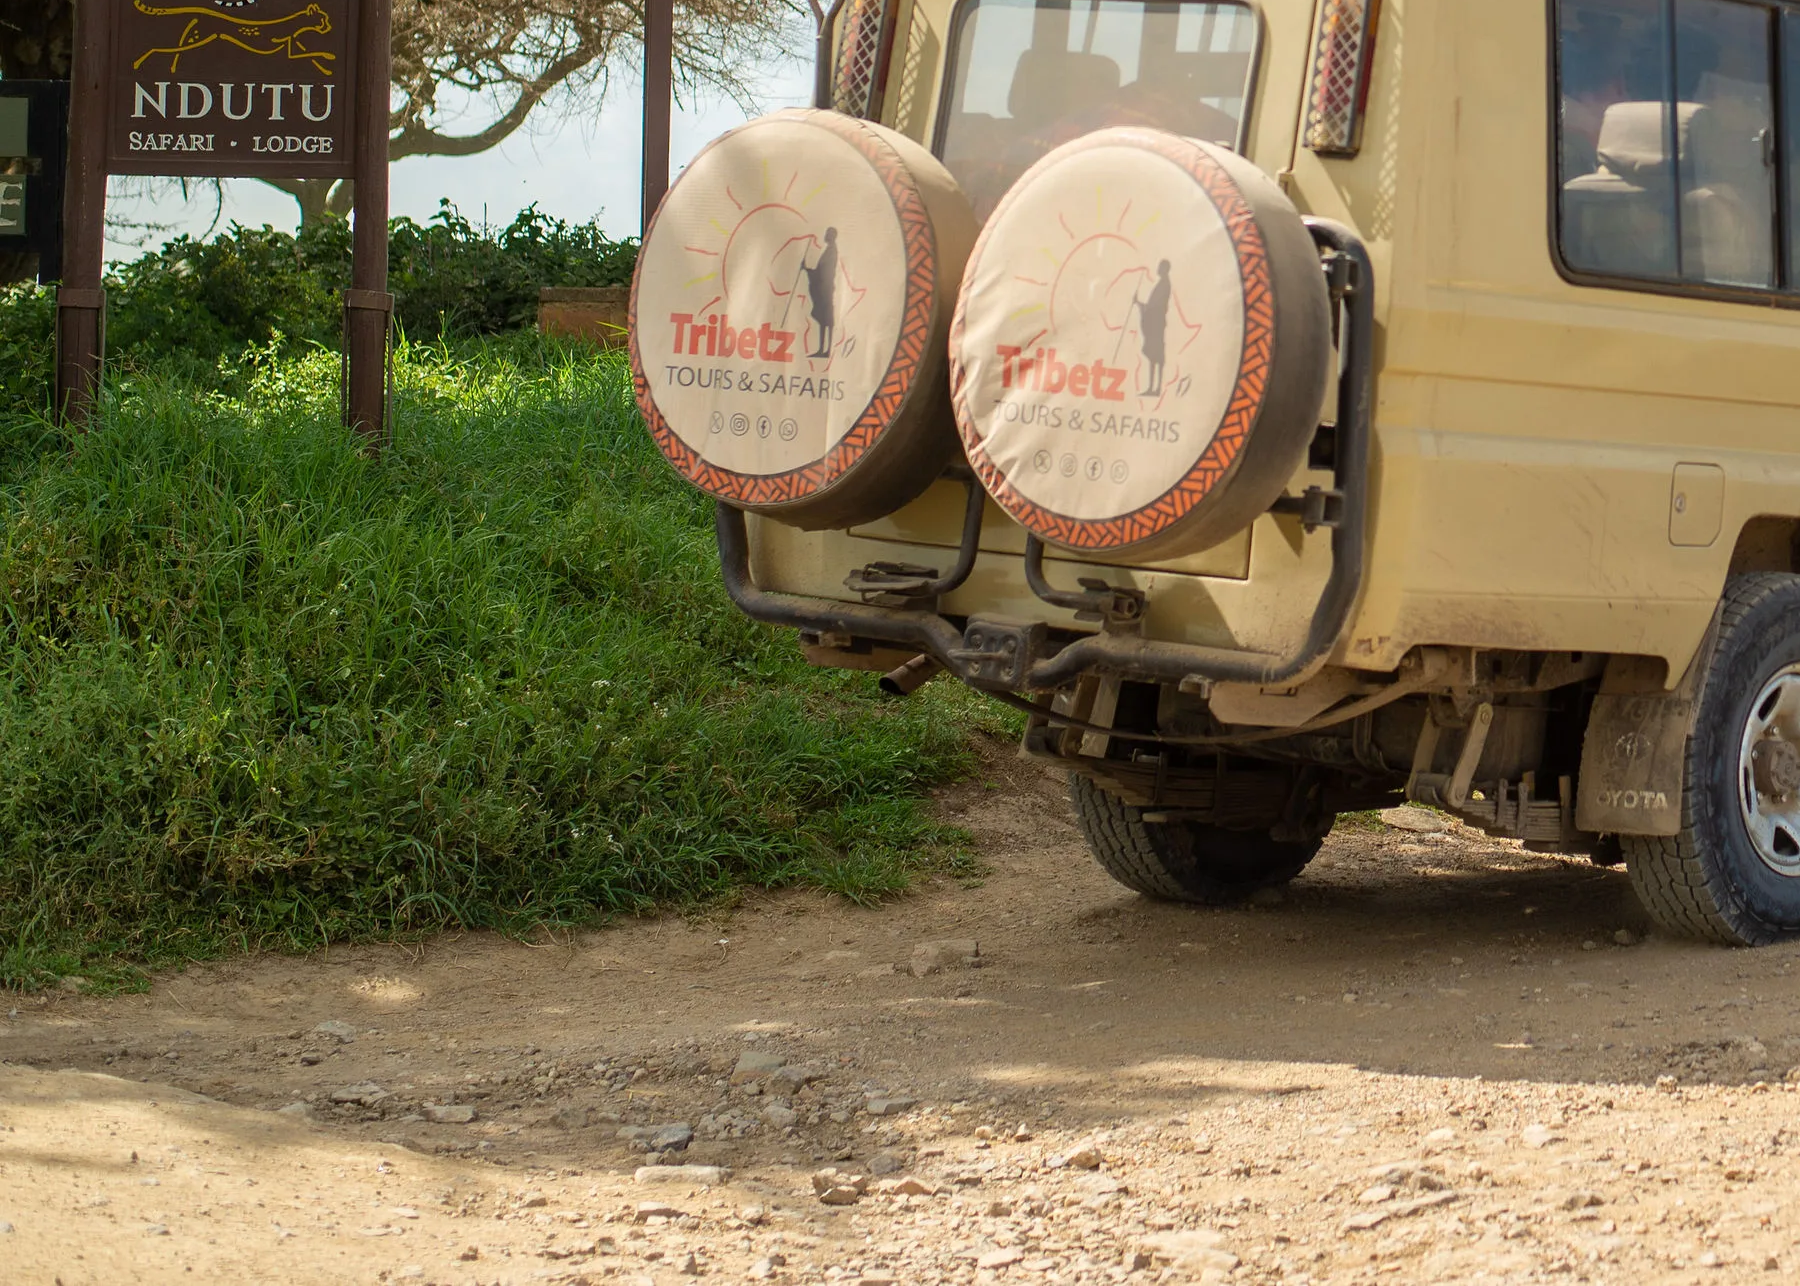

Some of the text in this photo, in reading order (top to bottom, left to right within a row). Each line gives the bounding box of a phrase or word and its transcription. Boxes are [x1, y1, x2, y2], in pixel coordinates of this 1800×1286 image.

[130, 81, 335, 122] NDUTU
[129, 131, 334, 153] SAFARI LODGE
[670, 312, 797, 363] Tribetz
[665, 365, 845, 401] TOURS & SAFARIS
[996, 344, 1128, 402] Tribetz
[1068, 409, 1084, 431] &
[1089, 411, 1181, 444] SAFARIS
